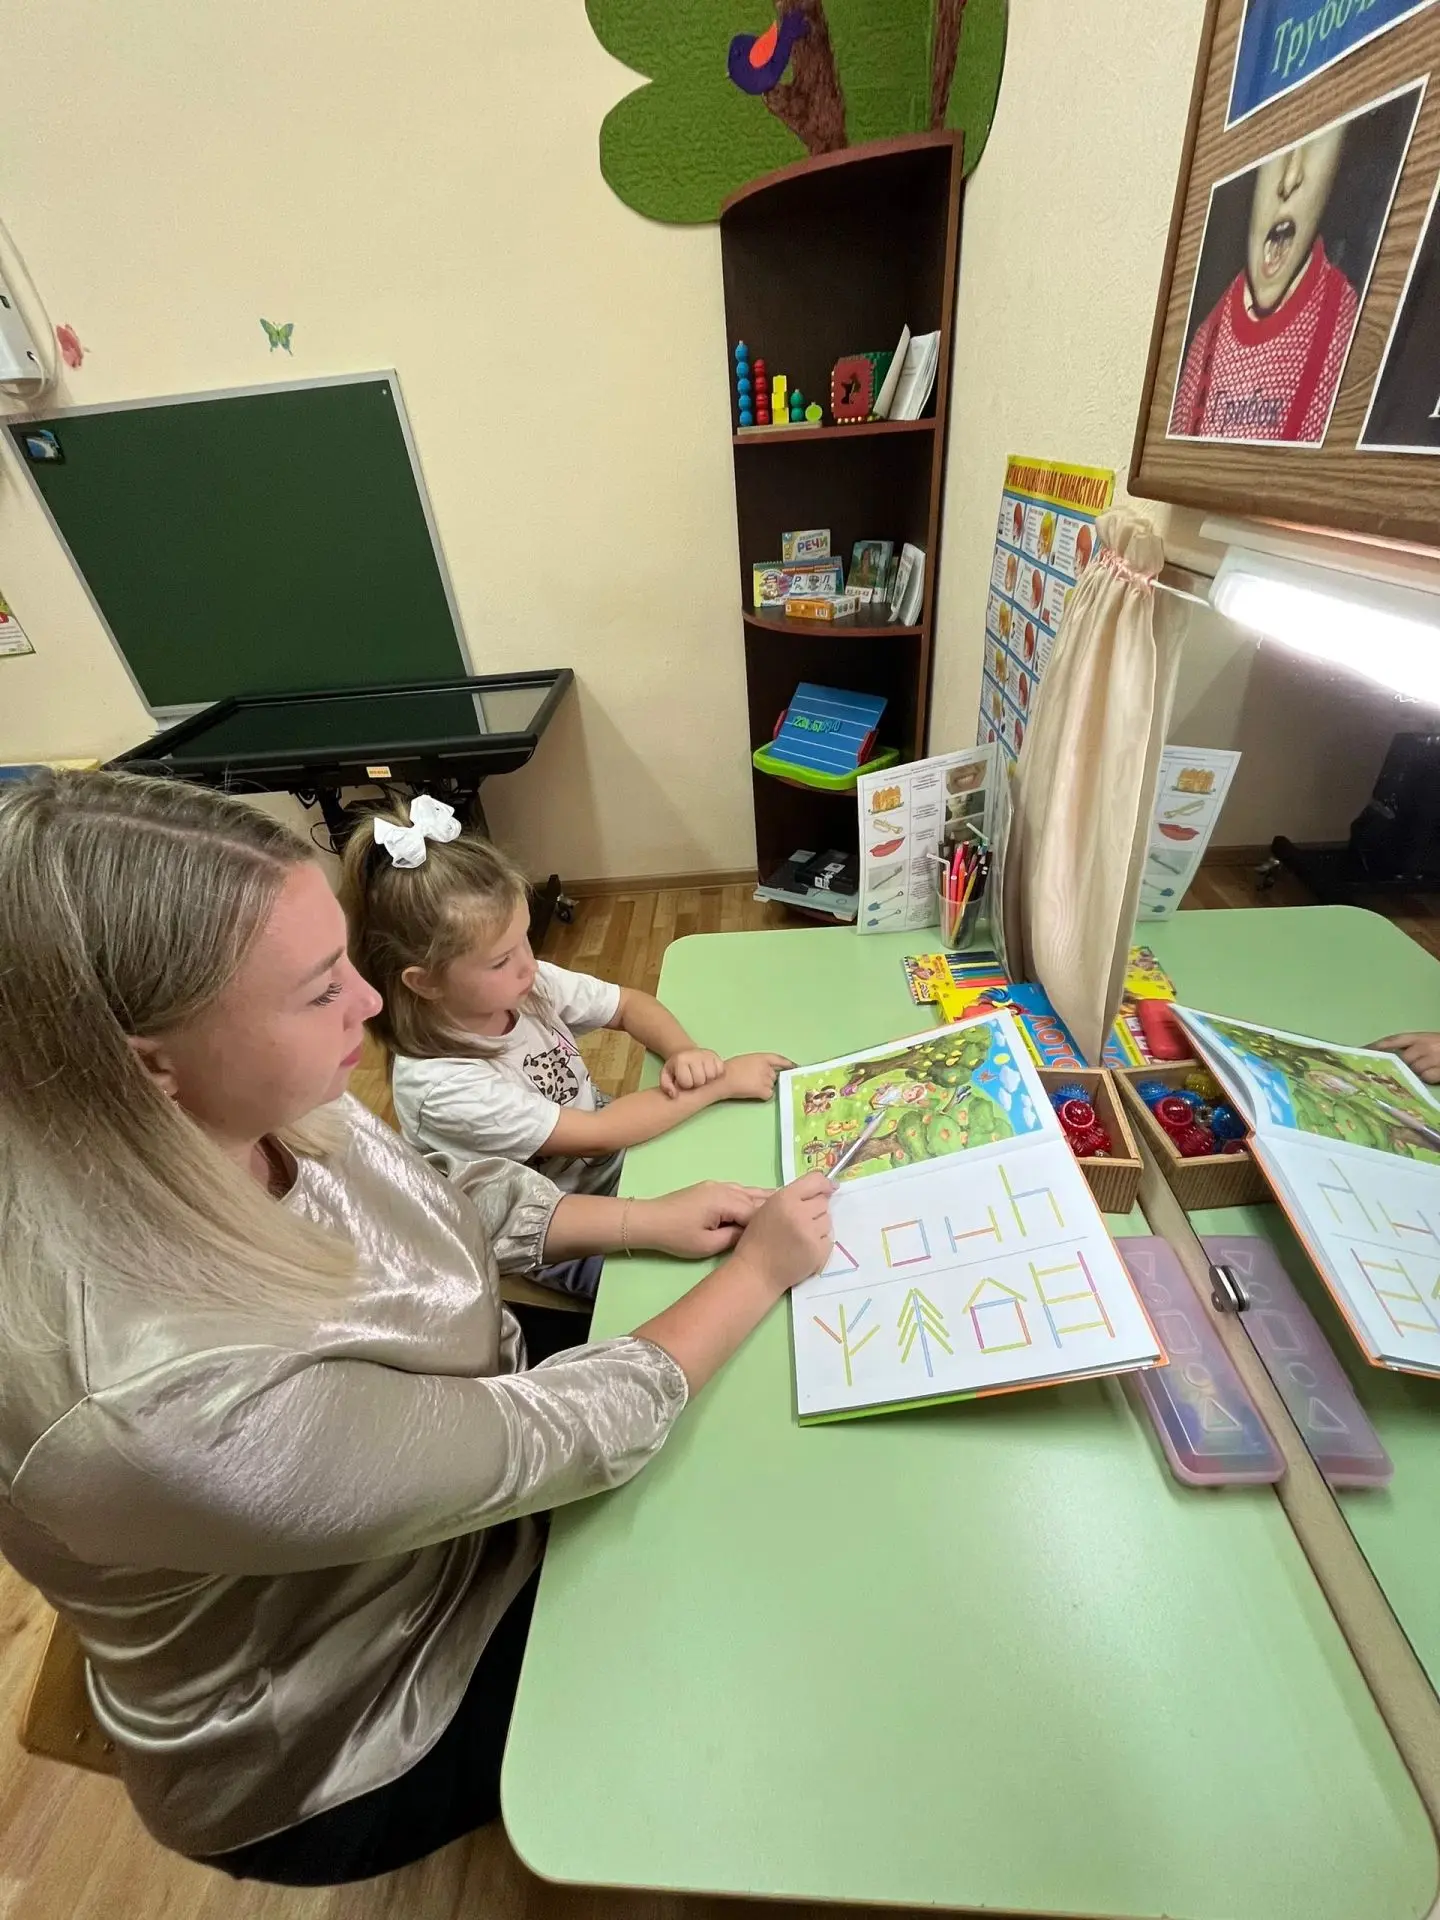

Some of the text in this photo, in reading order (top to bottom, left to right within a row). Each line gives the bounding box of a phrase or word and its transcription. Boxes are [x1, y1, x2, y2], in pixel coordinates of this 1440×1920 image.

[1211, 390, 1284, 434] Грибок
[797, 536, 828, 552] РЕЧИ
[1028, 1014, 1082, 1068] ЛОТО
